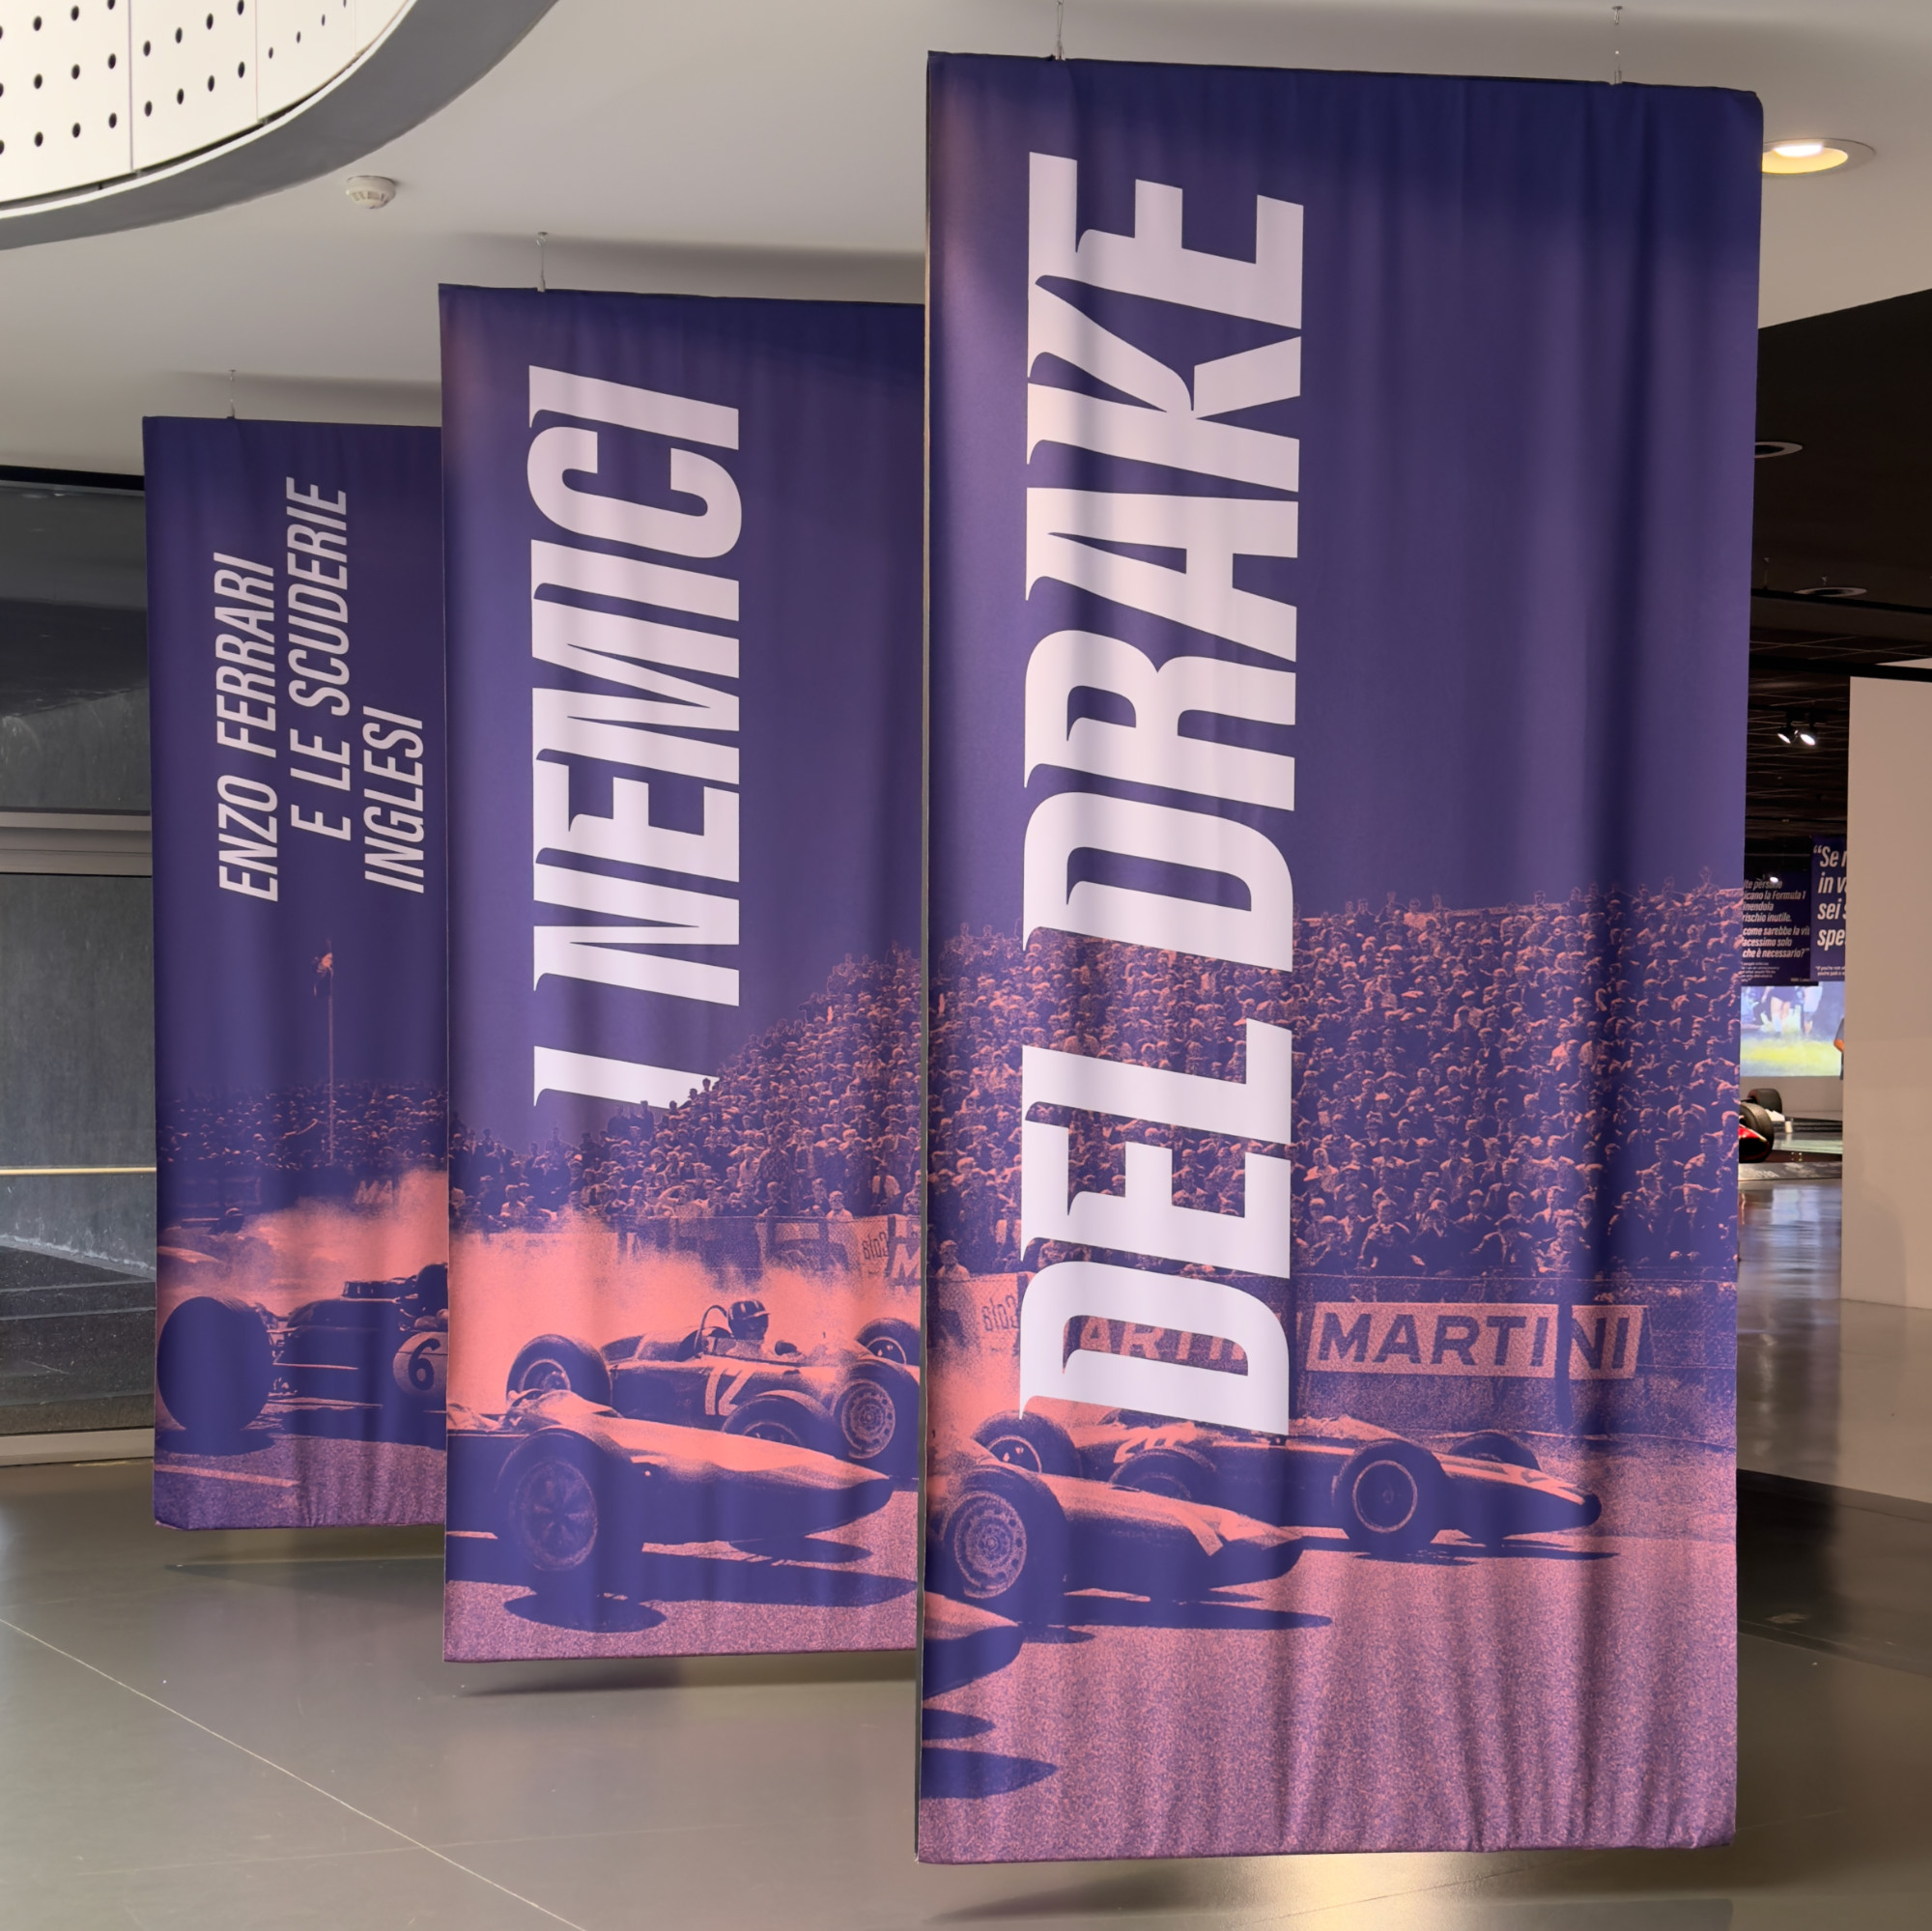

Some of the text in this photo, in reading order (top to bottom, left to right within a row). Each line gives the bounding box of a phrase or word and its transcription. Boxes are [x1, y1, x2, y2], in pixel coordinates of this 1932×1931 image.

[286, 476, 351, 841] E LE SCUDERIE
[213, 552, 278, 902] ENZO FERRARI
[527, 365, 742, 1111] I NEMICI
[362, 706, 424, 894] INGLESI
[1020, 152, 1304, 1435] DEL DRAKE
[1772, 890, 1802, 899] Formula
[1817, 871, 1833, 894] in
[1743, 927, 1763, 936] come
[1763, 925, 1792, 936] sarebbe
[1792, 925, 1801, 935] la
[1817, 897, 1842, 920] sei
[1742, 937, 1793, 947] acessimo solo
[1743, 948, 1755, 958] che
[1816, 928, 1847, 951] spe
[409, 1338, 441, 1391] 6
[1318, 1312, 1631, 1369] MARTINI
[705, 1366, 753, 1416] 12
